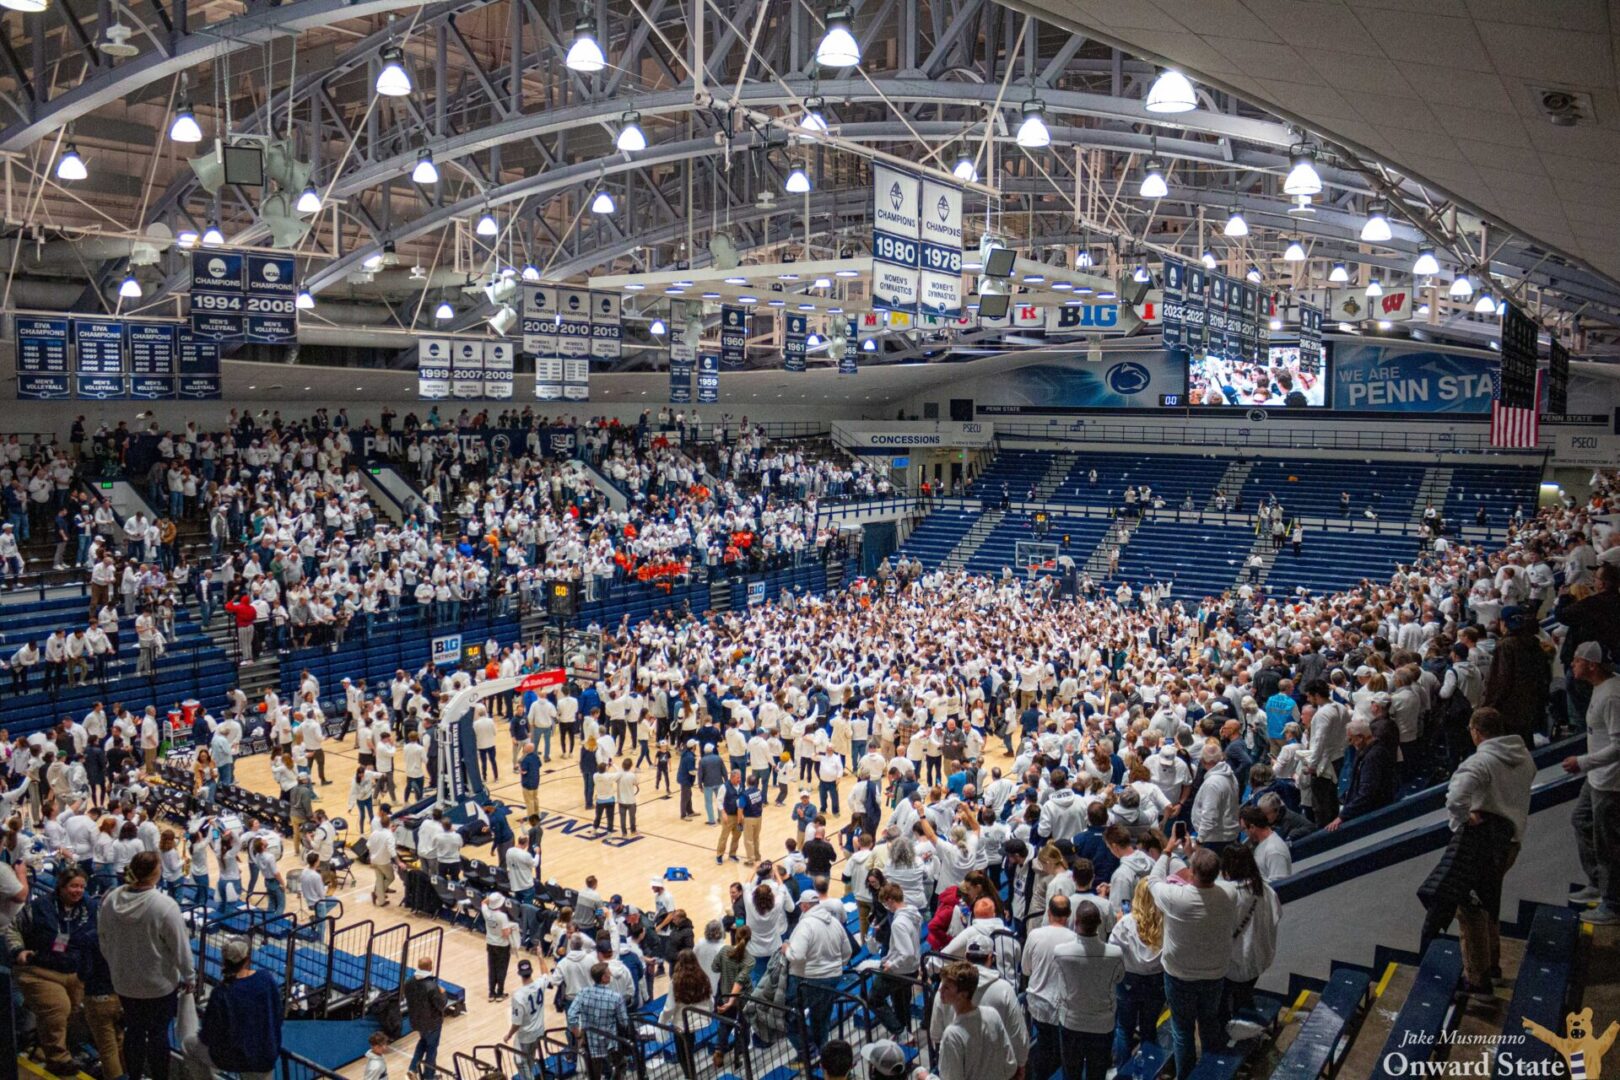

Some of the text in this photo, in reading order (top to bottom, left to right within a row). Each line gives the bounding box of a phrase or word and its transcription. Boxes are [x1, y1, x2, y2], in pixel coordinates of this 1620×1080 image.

[878, 209, 916, 228] CHAMPIONS
[926, 221, 962, 237] CHAMPIONS
[876, 237, 916, 263] 1980
[925, 247, 962, 271] 1978
[195, 278, 241, 287] CHAMPIONS
[884, 273, 908, 285] WOMEN'S
[251, 282, 292, 290] CHAMPIONS
[194, 295, 242, 310] 1994
[247, 298, 295, 313] 2008
[1164, 304, 1183, 319] 2023
[1186, 309, 1204, 323] 2022
[20, 328, 65, 336] CHAMPIONS
[524, 321, 557, 333] 2009
[560, 324, 589, 335] 2010
[593, 327, 619, 337] 2013
[79, 331, 121, 339] CHAMPIONS
[132, 333, 171, 341] CHAMPIONS
[723, 337, 745, 346] 1960
[787, 343, 805, 352] 1961
[844, 347, 857, 355] 965
[420, 369, 449, 378] 1999
[454, 370, 483, 379] 2007
[485, 371, 513, 380] 2008
[1339, 366, 1400, 383] WE ARE
[699, 378, 718, 386] 1959
[1349, 378, 1429, 406] PENN
[1438, 373, 1493, 401] STA
[963, 423, 982, 433] PSECU
[871, 435, 941, 445] CONCESSIONS
[1572, 436, 1598, 449] PSECU
[528, 988, 545, 1015] 14
